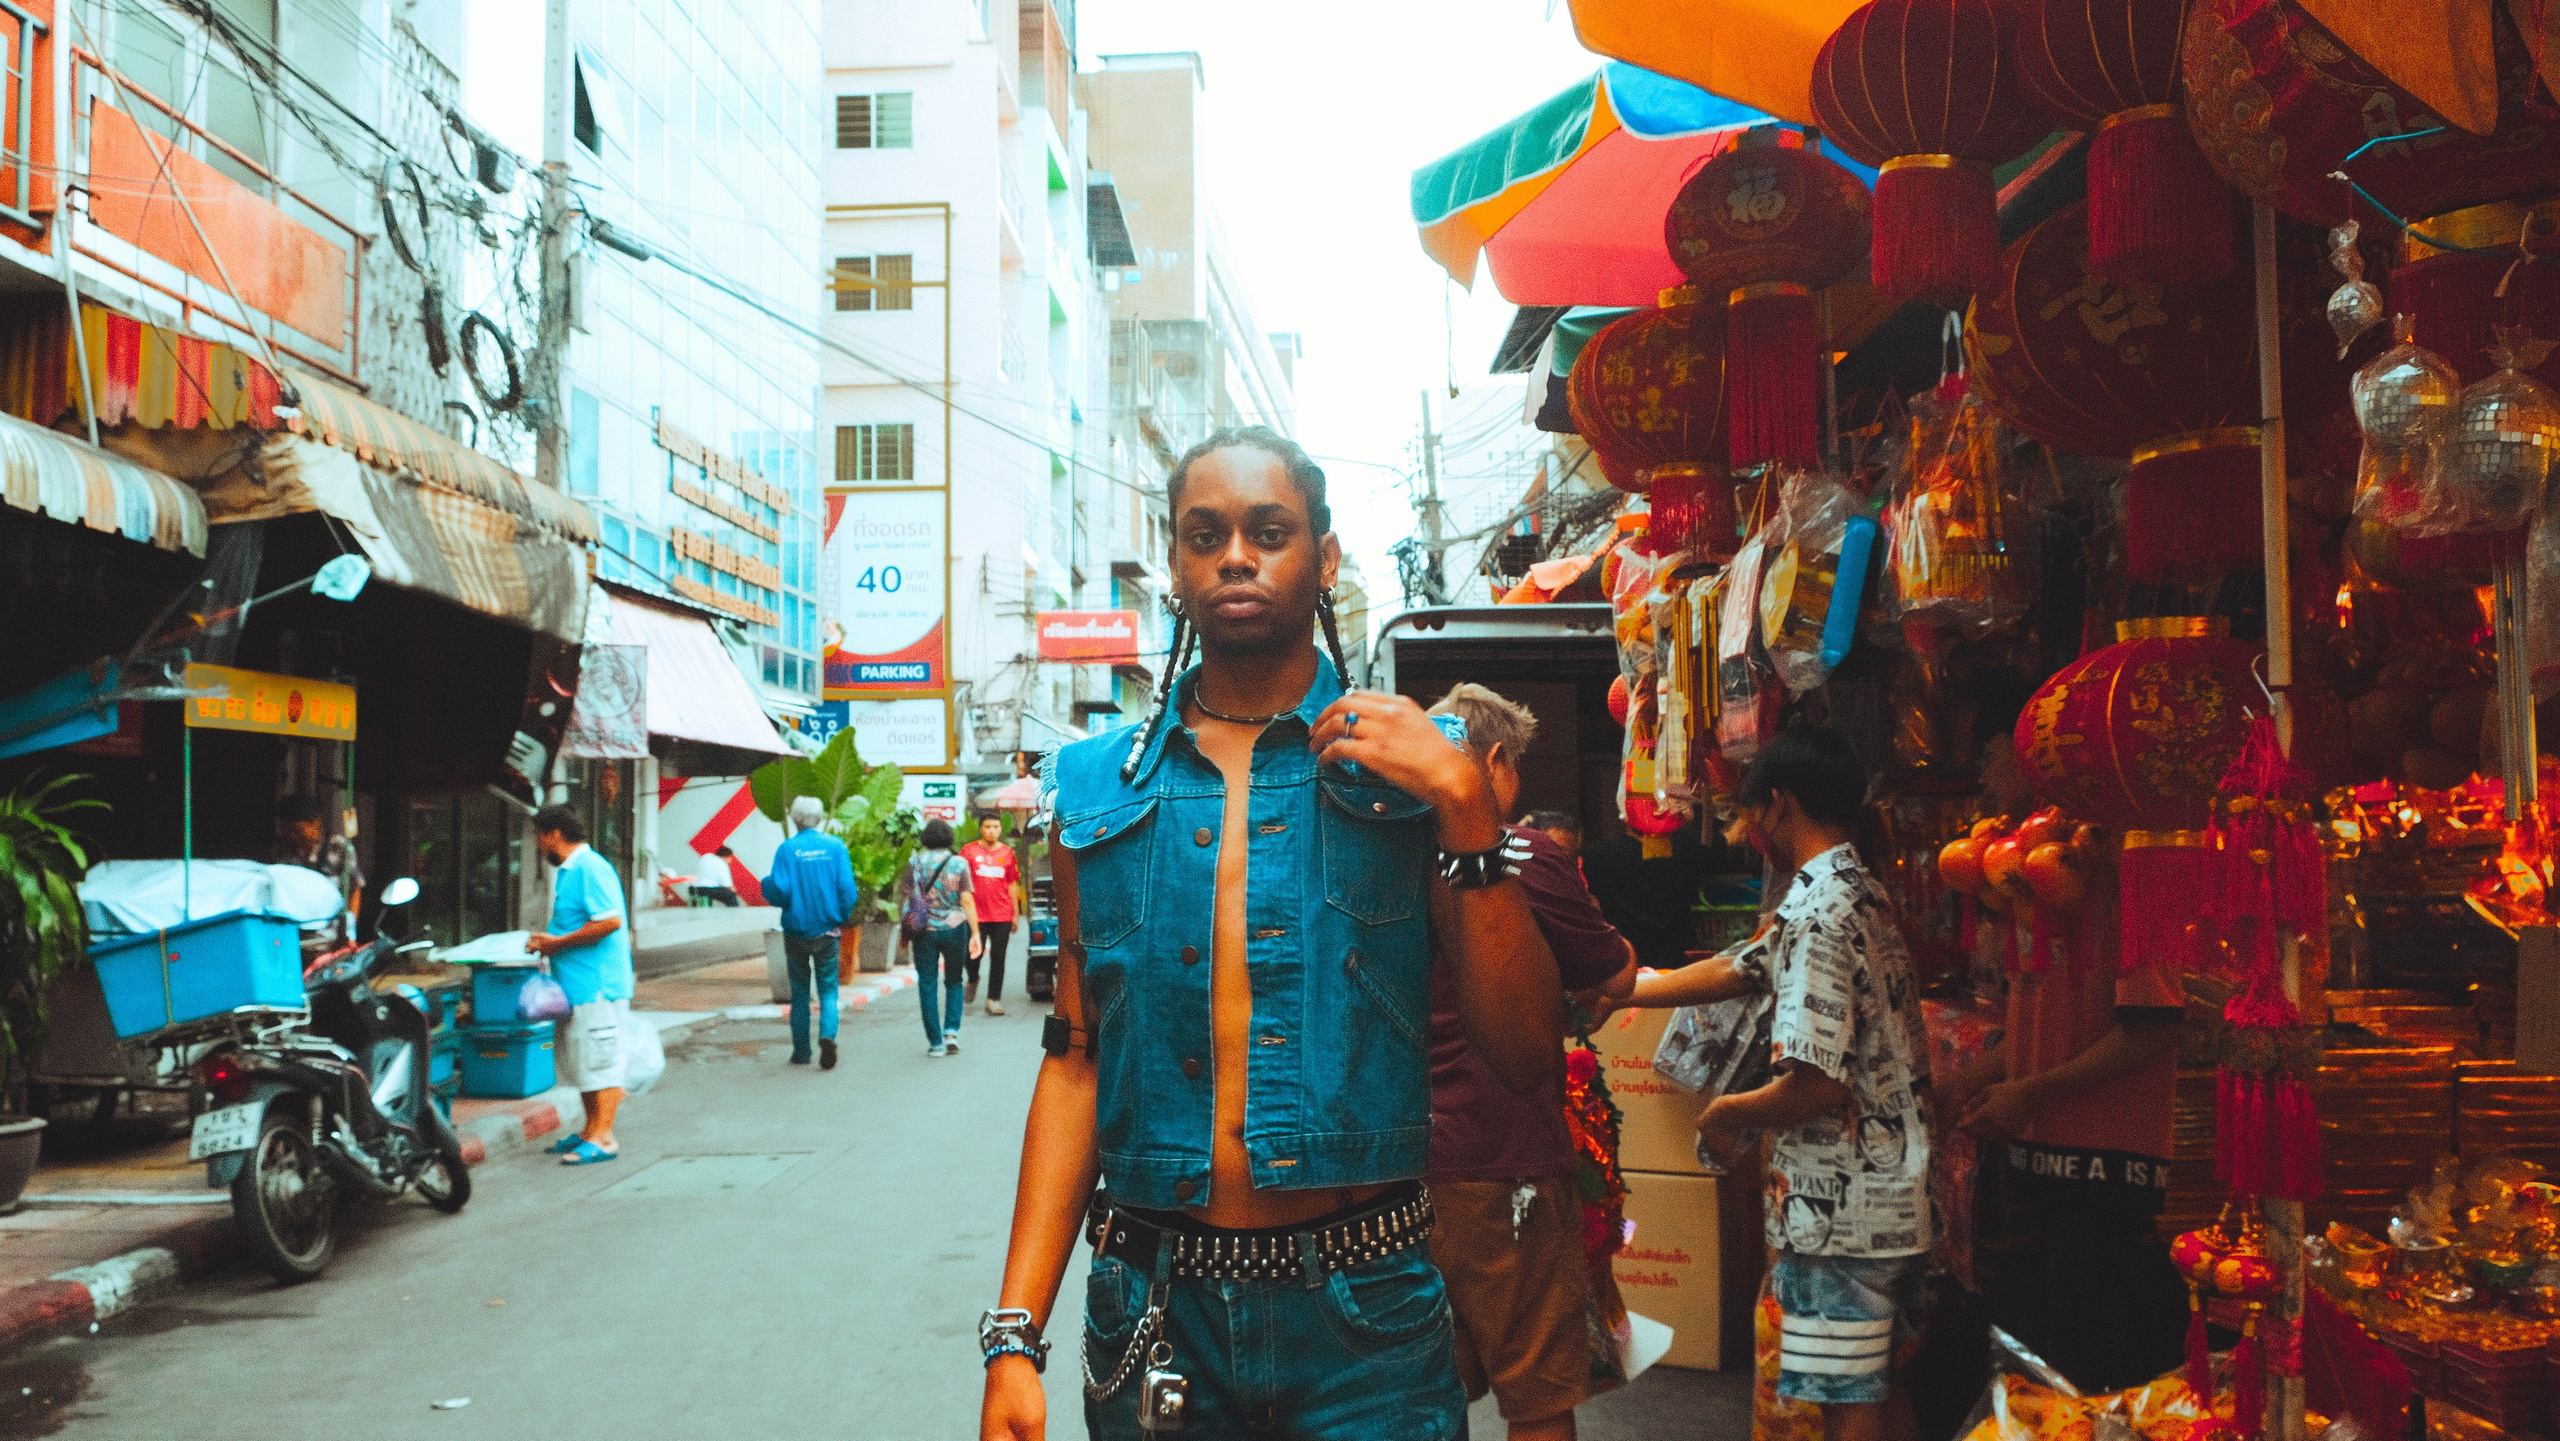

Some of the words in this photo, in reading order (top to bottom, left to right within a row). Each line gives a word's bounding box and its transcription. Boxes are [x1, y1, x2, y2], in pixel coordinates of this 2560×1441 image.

[854, 512, 931, 537] ที่จอดรถ
[856, 565, 902, 593] 40
[905, 570, 929, 581] บาท
[861, 664, 925, 680] PARKING
[855, 708, 937, 725] ห้องน้ำสะอาด
[887, 729, 936, 745] ติดแอร์
[2032, 1151, 2081, 1179] ONE
[2087, 1156, 2107, 1180] A
[2125, 1160, 2148, 1186] IS
